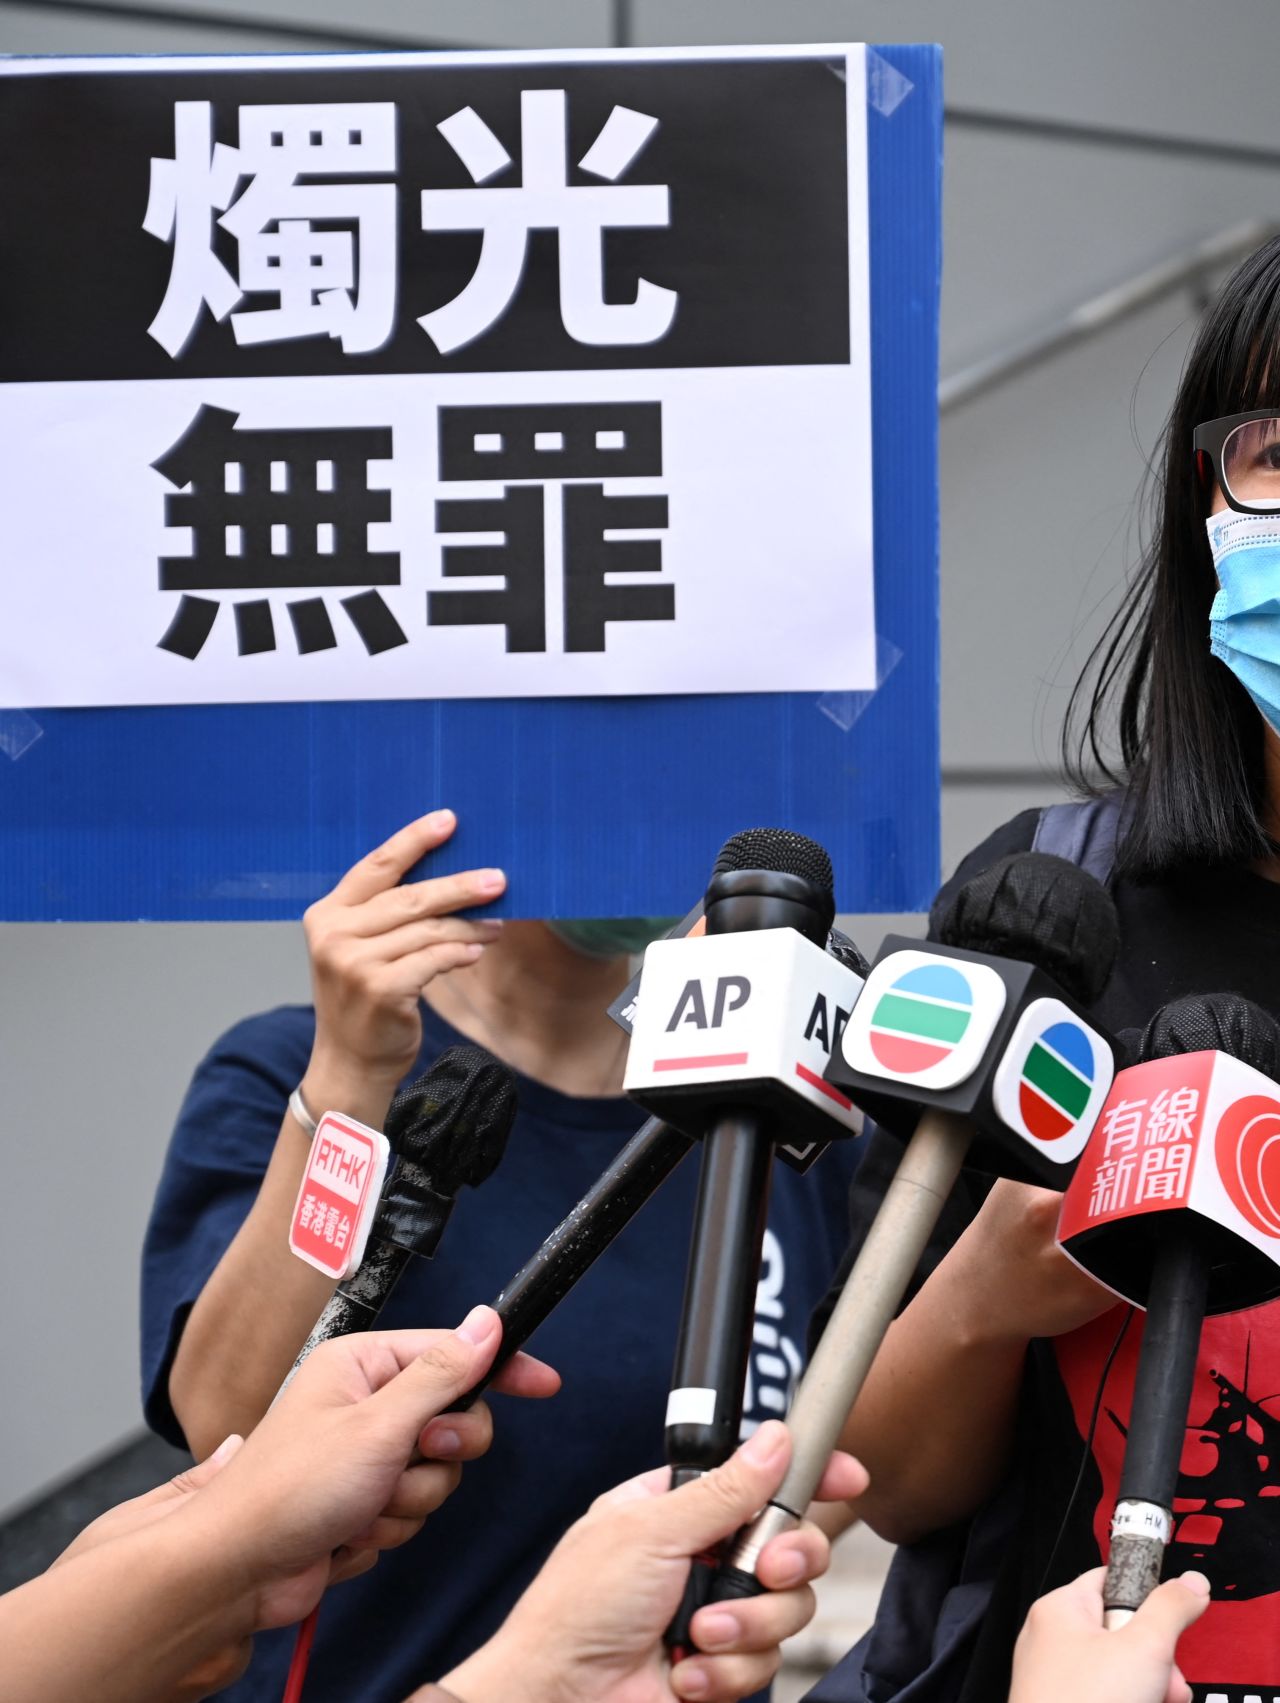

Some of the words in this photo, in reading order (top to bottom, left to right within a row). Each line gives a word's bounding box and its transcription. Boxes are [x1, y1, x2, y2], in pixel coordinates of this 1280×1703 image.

[142, 88, 678, 359] 燭光
[150, 400, 676, 661] 無罪
[665, 975, 751, 1033] AP
[1102, 1086, 1200, 1159] 有線
[315, 1137, 366, 1190] RTHK
[1087, 1143, 1192, 1217] 新聞
